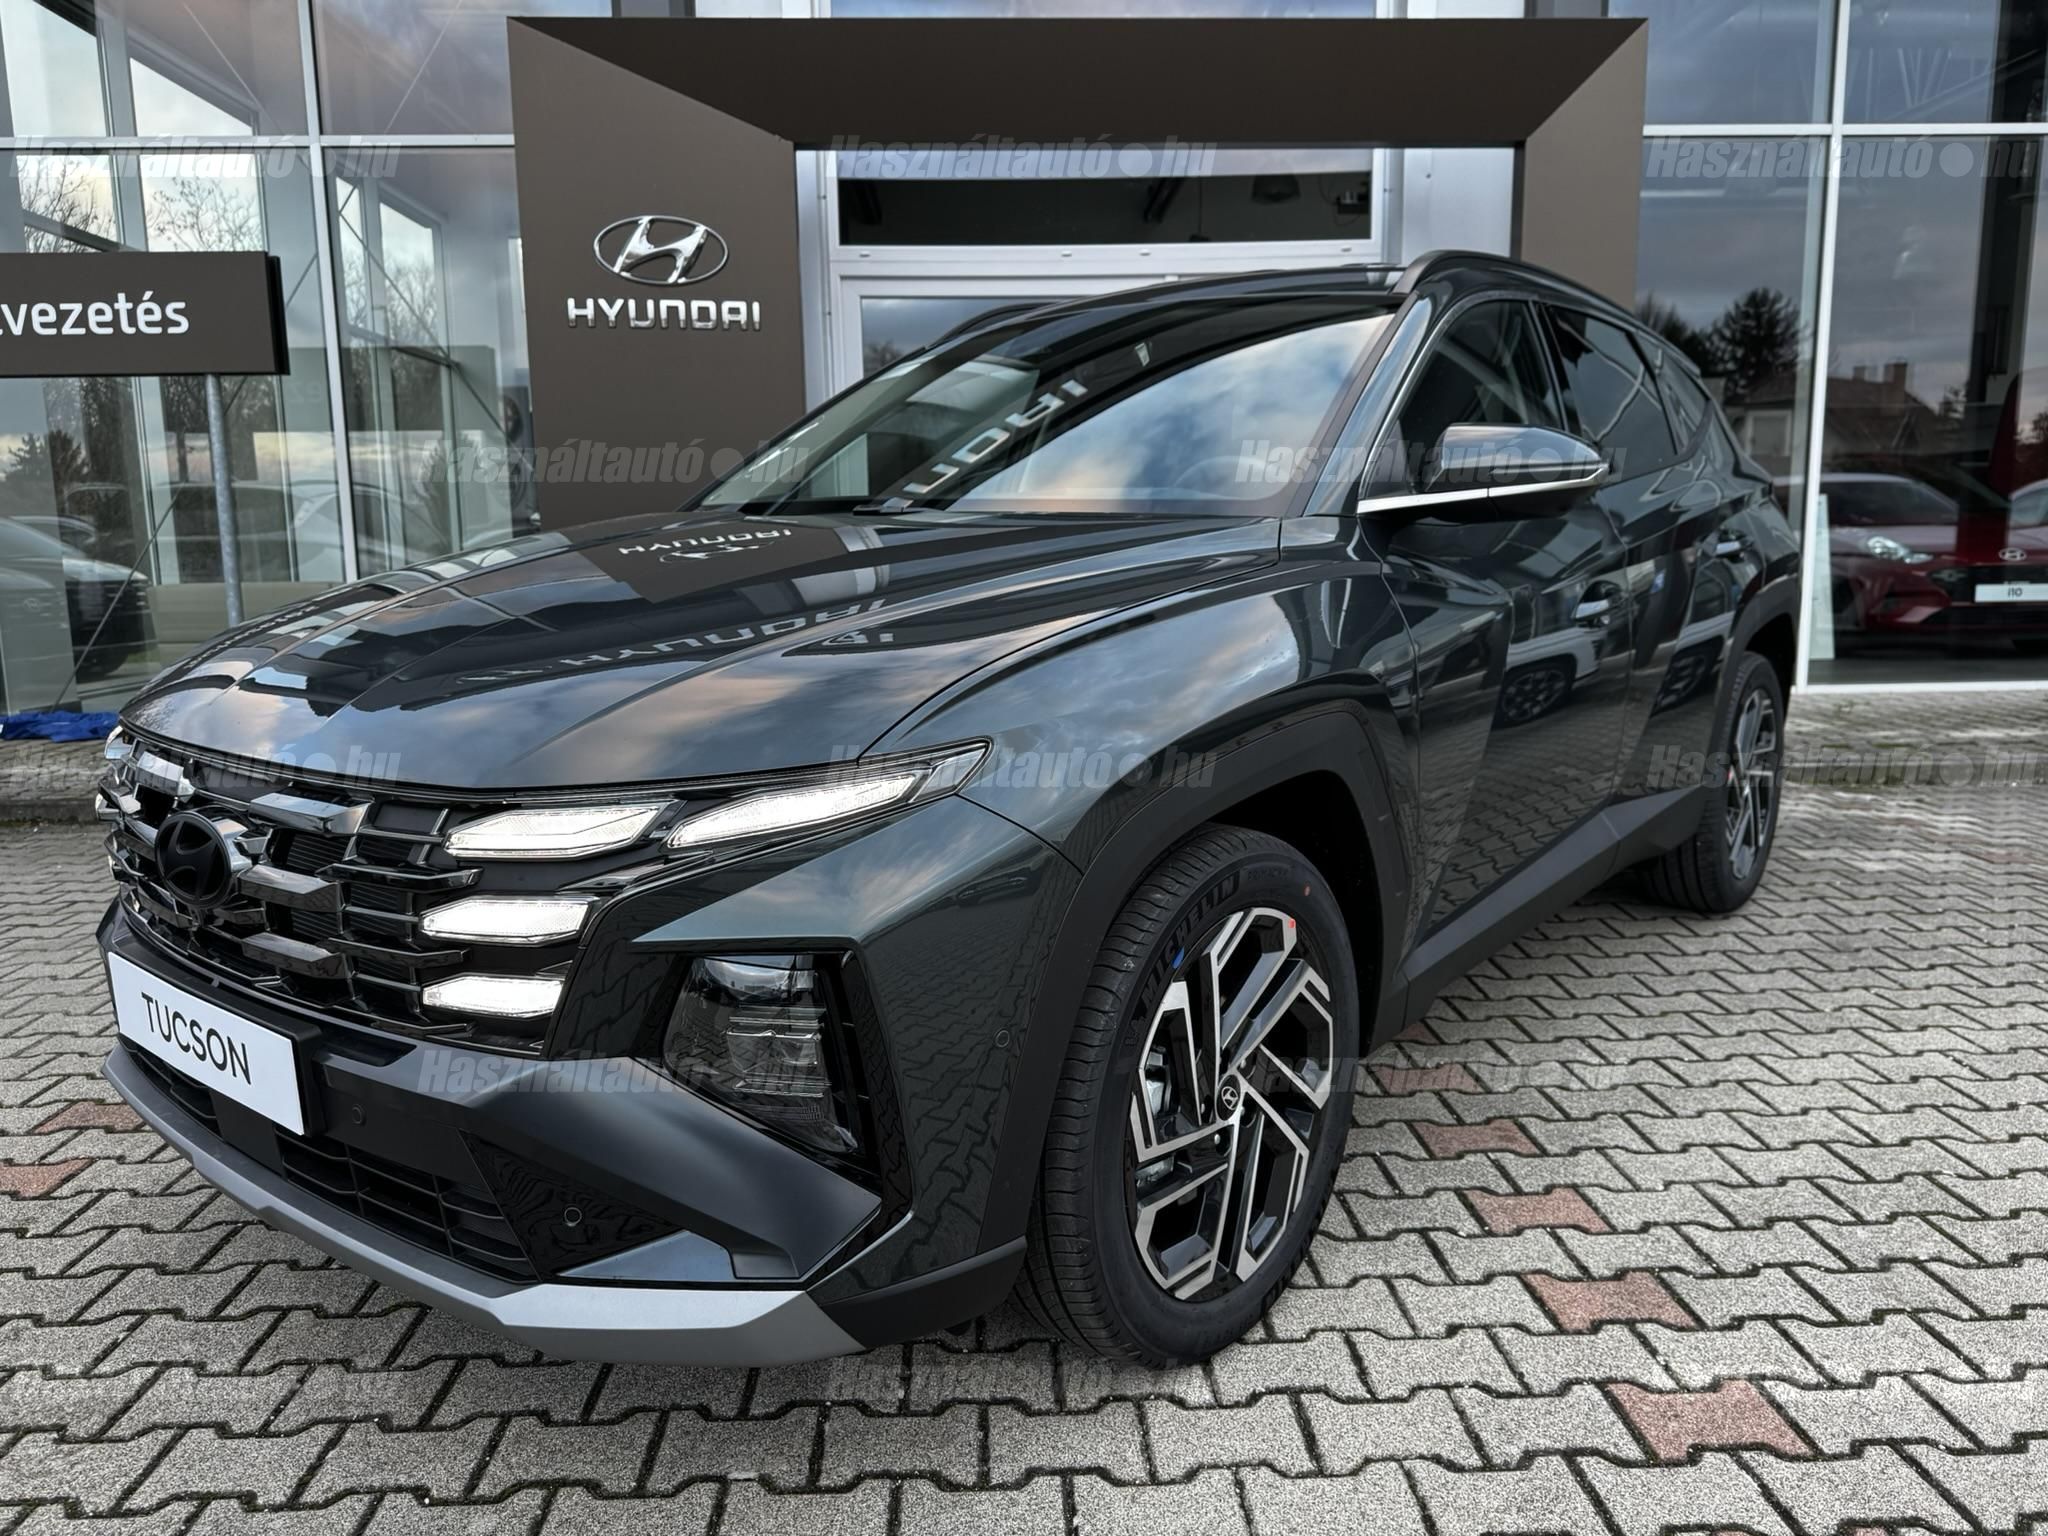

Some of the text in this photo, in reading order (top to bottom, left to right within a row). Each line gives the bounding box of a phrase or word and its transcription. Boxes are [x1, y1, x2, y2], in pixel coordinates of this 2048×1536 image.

[0, 290, 190, 336] vezetés
[567, 297, 761, 330] HYUNDAI
[141, 991, 251, 1085] TUCSON
